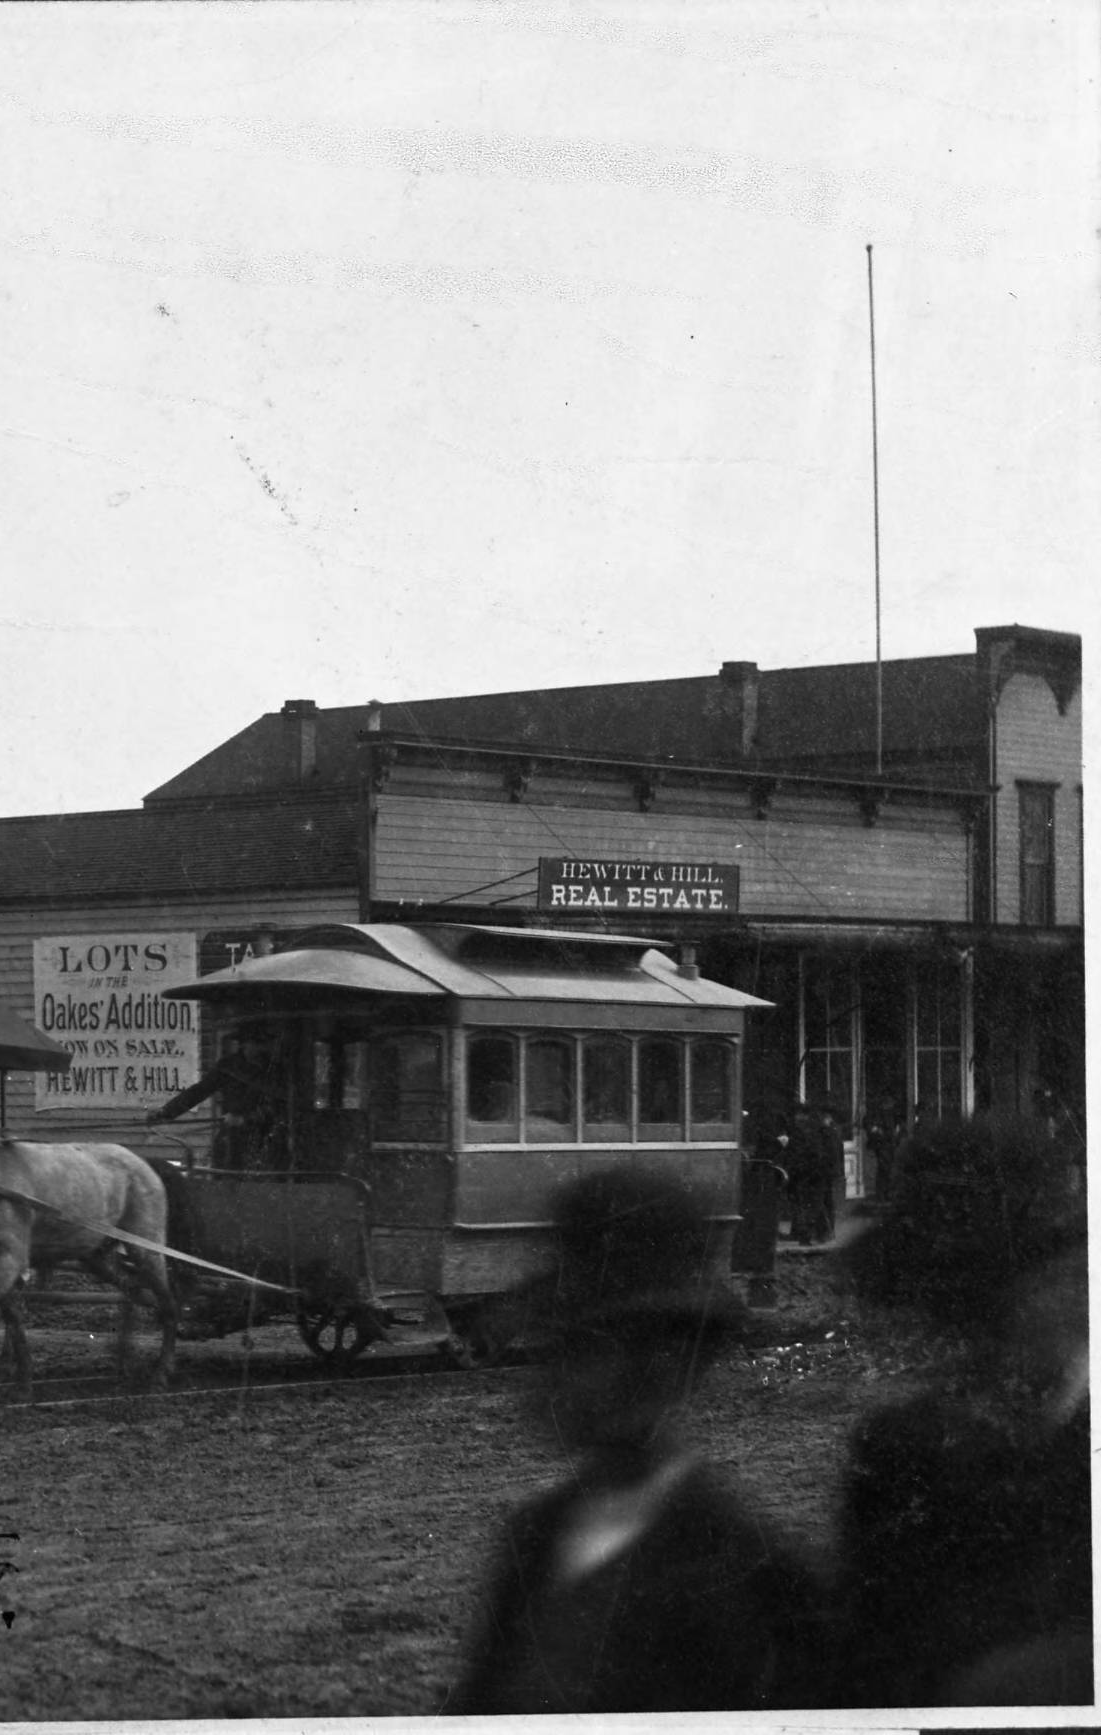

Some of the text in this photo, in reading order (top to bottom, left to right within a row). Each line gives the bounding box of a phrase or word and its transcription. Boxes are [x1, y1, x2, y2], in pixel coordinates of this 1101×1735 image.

[561, 861, 651, 881] HEWITT
[653, 866, 666, 882] &
[550, 884, 729, 910] REAL ESTATE.
[58, 942, 168, 973] LOTS
[88, 975, 128, 989] IN THE
[42, 993, 105, 1031] Oakes'
[94, 1039, 119, 1058] ON
[124, 1067, 139, 1092] &
